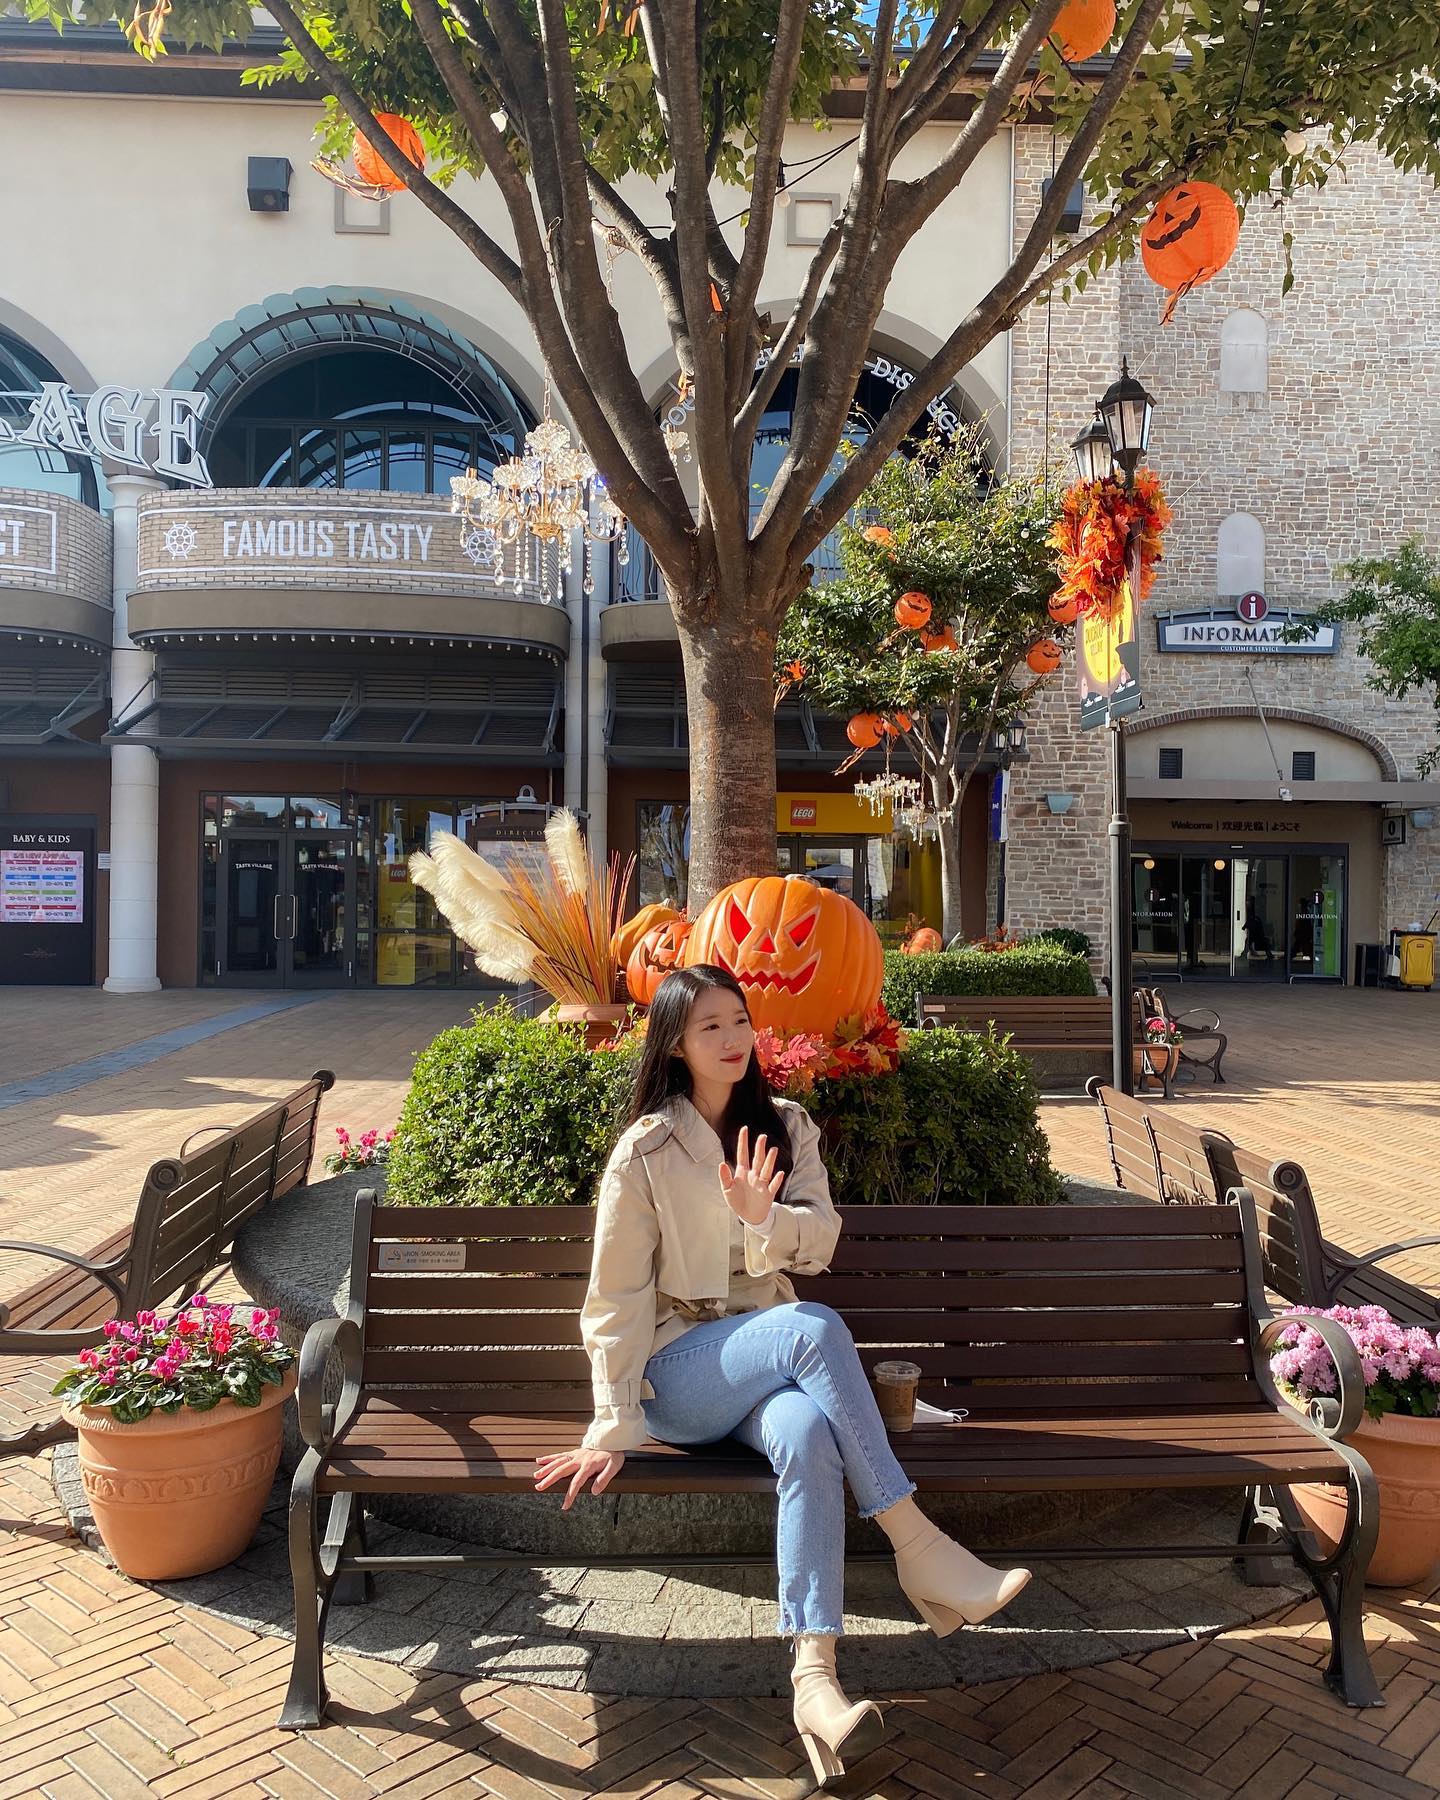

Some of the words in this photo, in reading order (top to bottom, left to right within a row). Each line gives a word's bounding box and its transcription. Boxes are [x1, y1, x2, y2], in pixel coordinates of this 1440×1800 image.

[223, 520, 335, 557] FAMOUS
[343, 521, 433, 561] TASTY
[1183, 627, 1317, 642] INFORMATN
[793, 808, 813, 818] LEGO
[1171, 820, 1213, 829] Welcome
[1271, 822, 1300, 832] ようこそ
[12, 834, 36, 843] BABY
[38, 835, 45, 843] &
[47, 835, 71, 843] KIDS
[391, 868, 406, 877] LEGO
